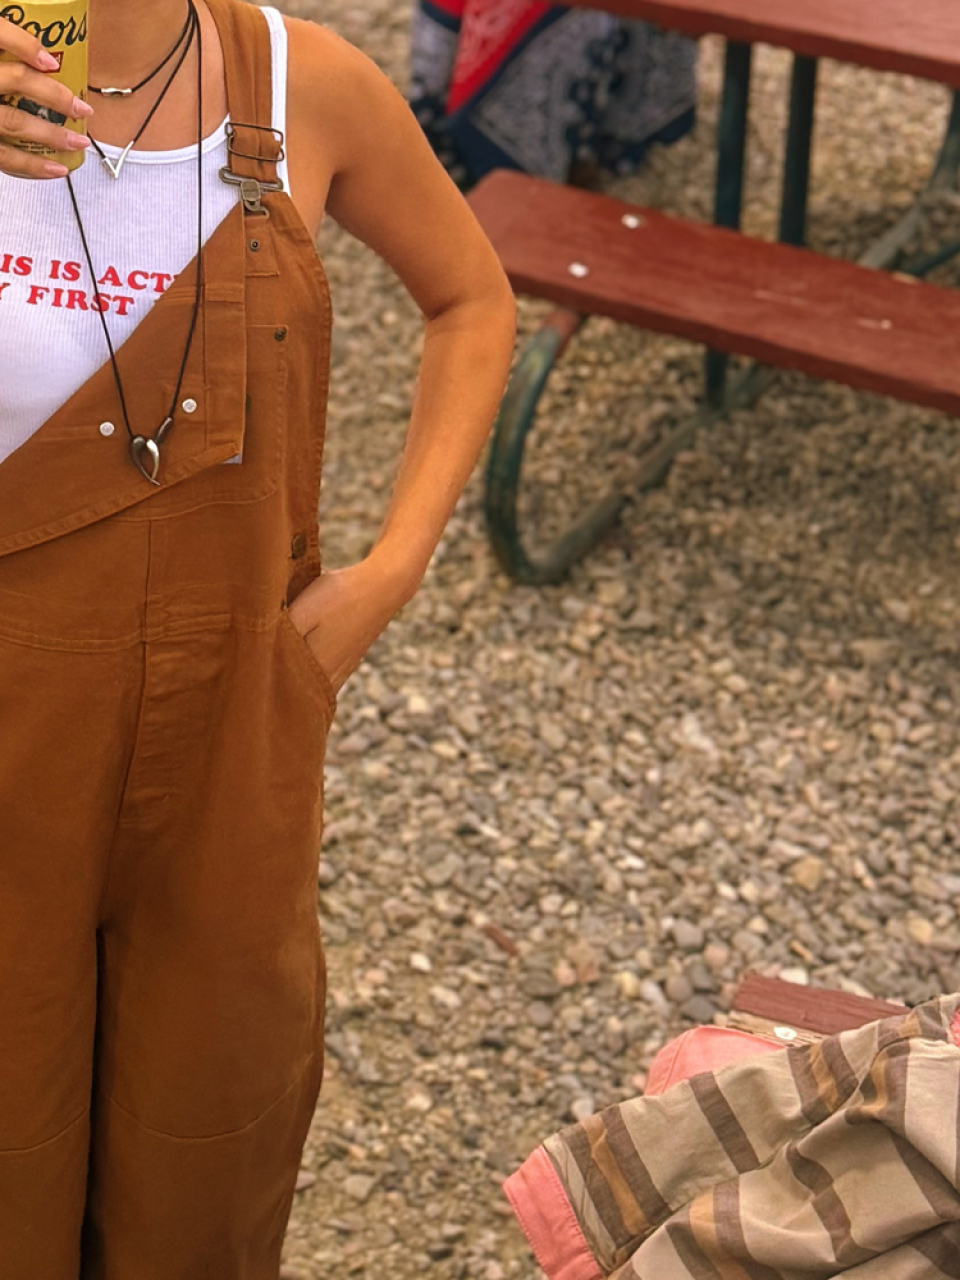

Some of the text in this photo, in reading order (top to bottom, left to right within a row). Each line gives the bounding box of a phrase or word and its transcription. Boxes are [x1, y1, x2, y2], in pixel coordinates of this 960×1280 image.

[49, 259, 81, 282] IS
[96, 265, 179, 293] ACT
[26, 284, 134, 316] FIRST
